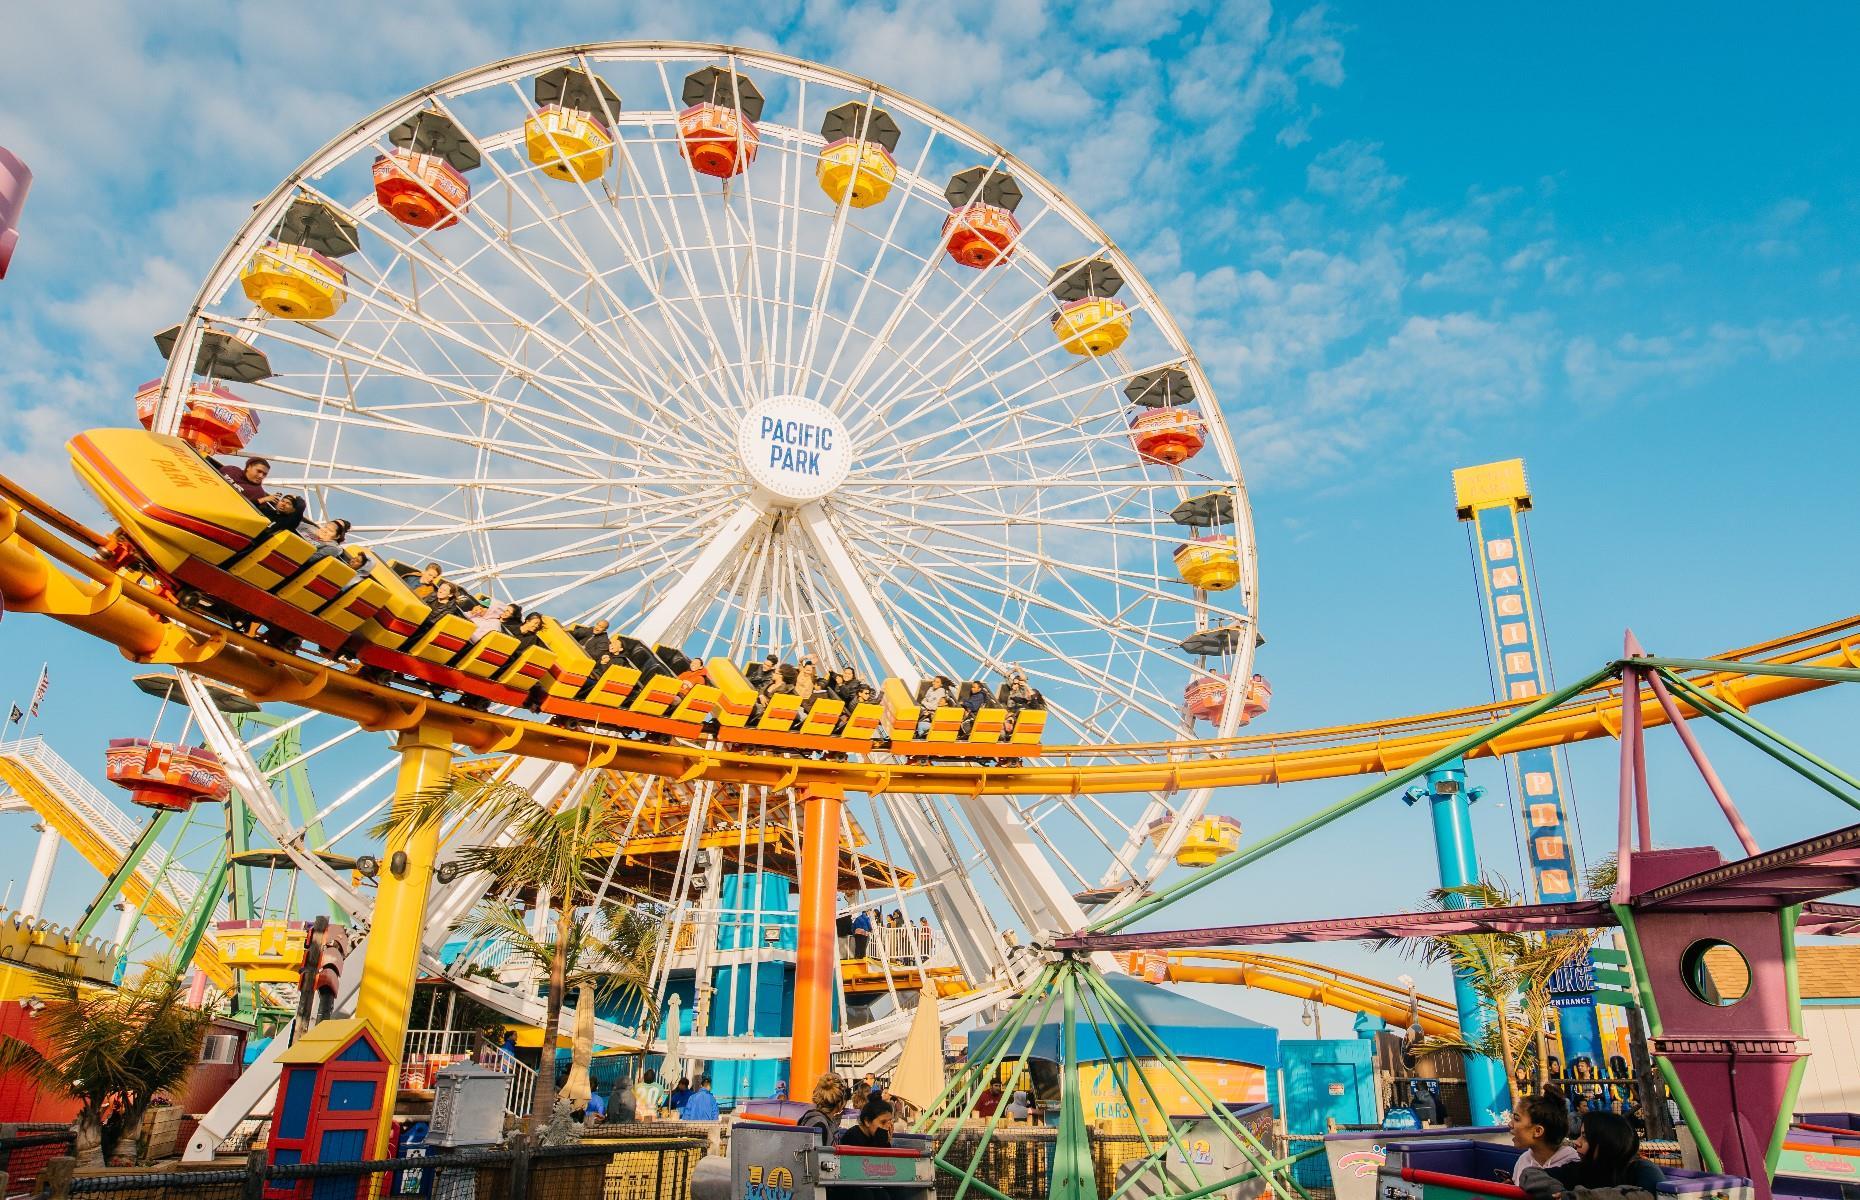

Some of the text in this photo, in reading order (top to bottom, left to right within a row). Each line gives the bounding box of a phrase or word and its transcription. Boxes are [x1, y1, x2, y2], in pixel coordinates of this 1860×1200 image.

[761, 416, 833, 451] PACIFIC
[152, 459, 199, 488] PARK
[163, 444, 220, 487] PACIFIC
[770, 444, 821, 476] PARK
[1494, 541, 1528, 699] PACIFI
[1533, 775, 1565, 892] PLUN
[1542, 966, 1595, 993] LUNGE
[1550, 997, 1591, 1006] ENTRANCE
[1410, 1080, 1437, 1088] ETER
[1095, 1102, 1129, 1119] YEARS
